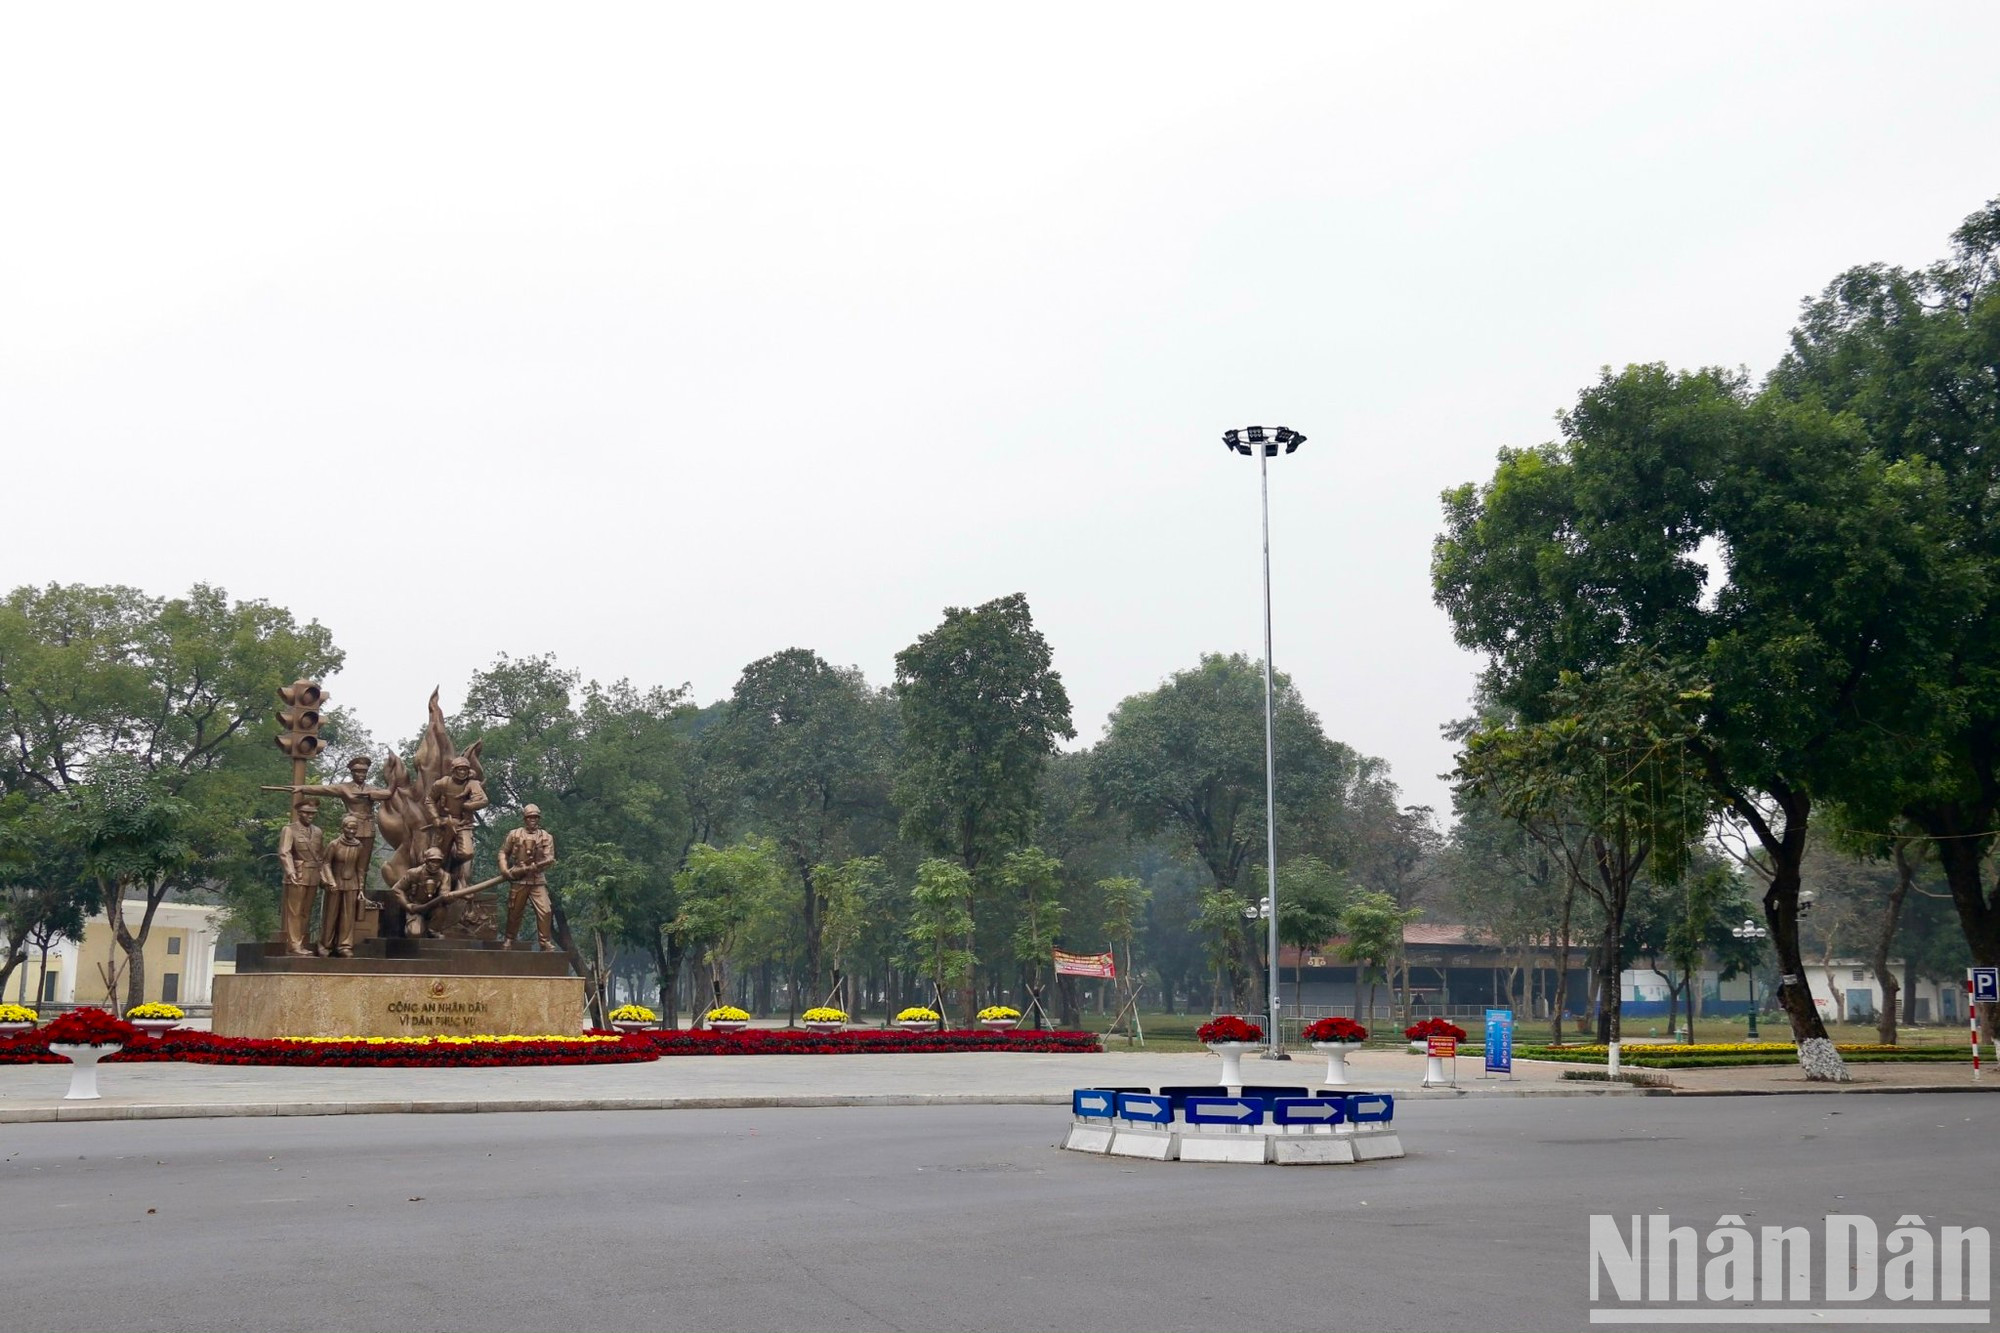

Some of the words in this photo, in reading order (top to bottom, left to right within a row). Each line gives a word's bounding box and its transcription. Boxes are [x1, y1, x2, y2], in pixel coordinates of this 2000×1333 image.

[1977, 974, 1992, 993] P
[388, 1001, 418, 1013] CÔNG
[421, 1003, 435, 1012] AN
[438, 1002, 466, 1013] NHÂN
[468, 1001, 488, 1013] DÂN
[412, 1015, 433, 1026] DÂN
